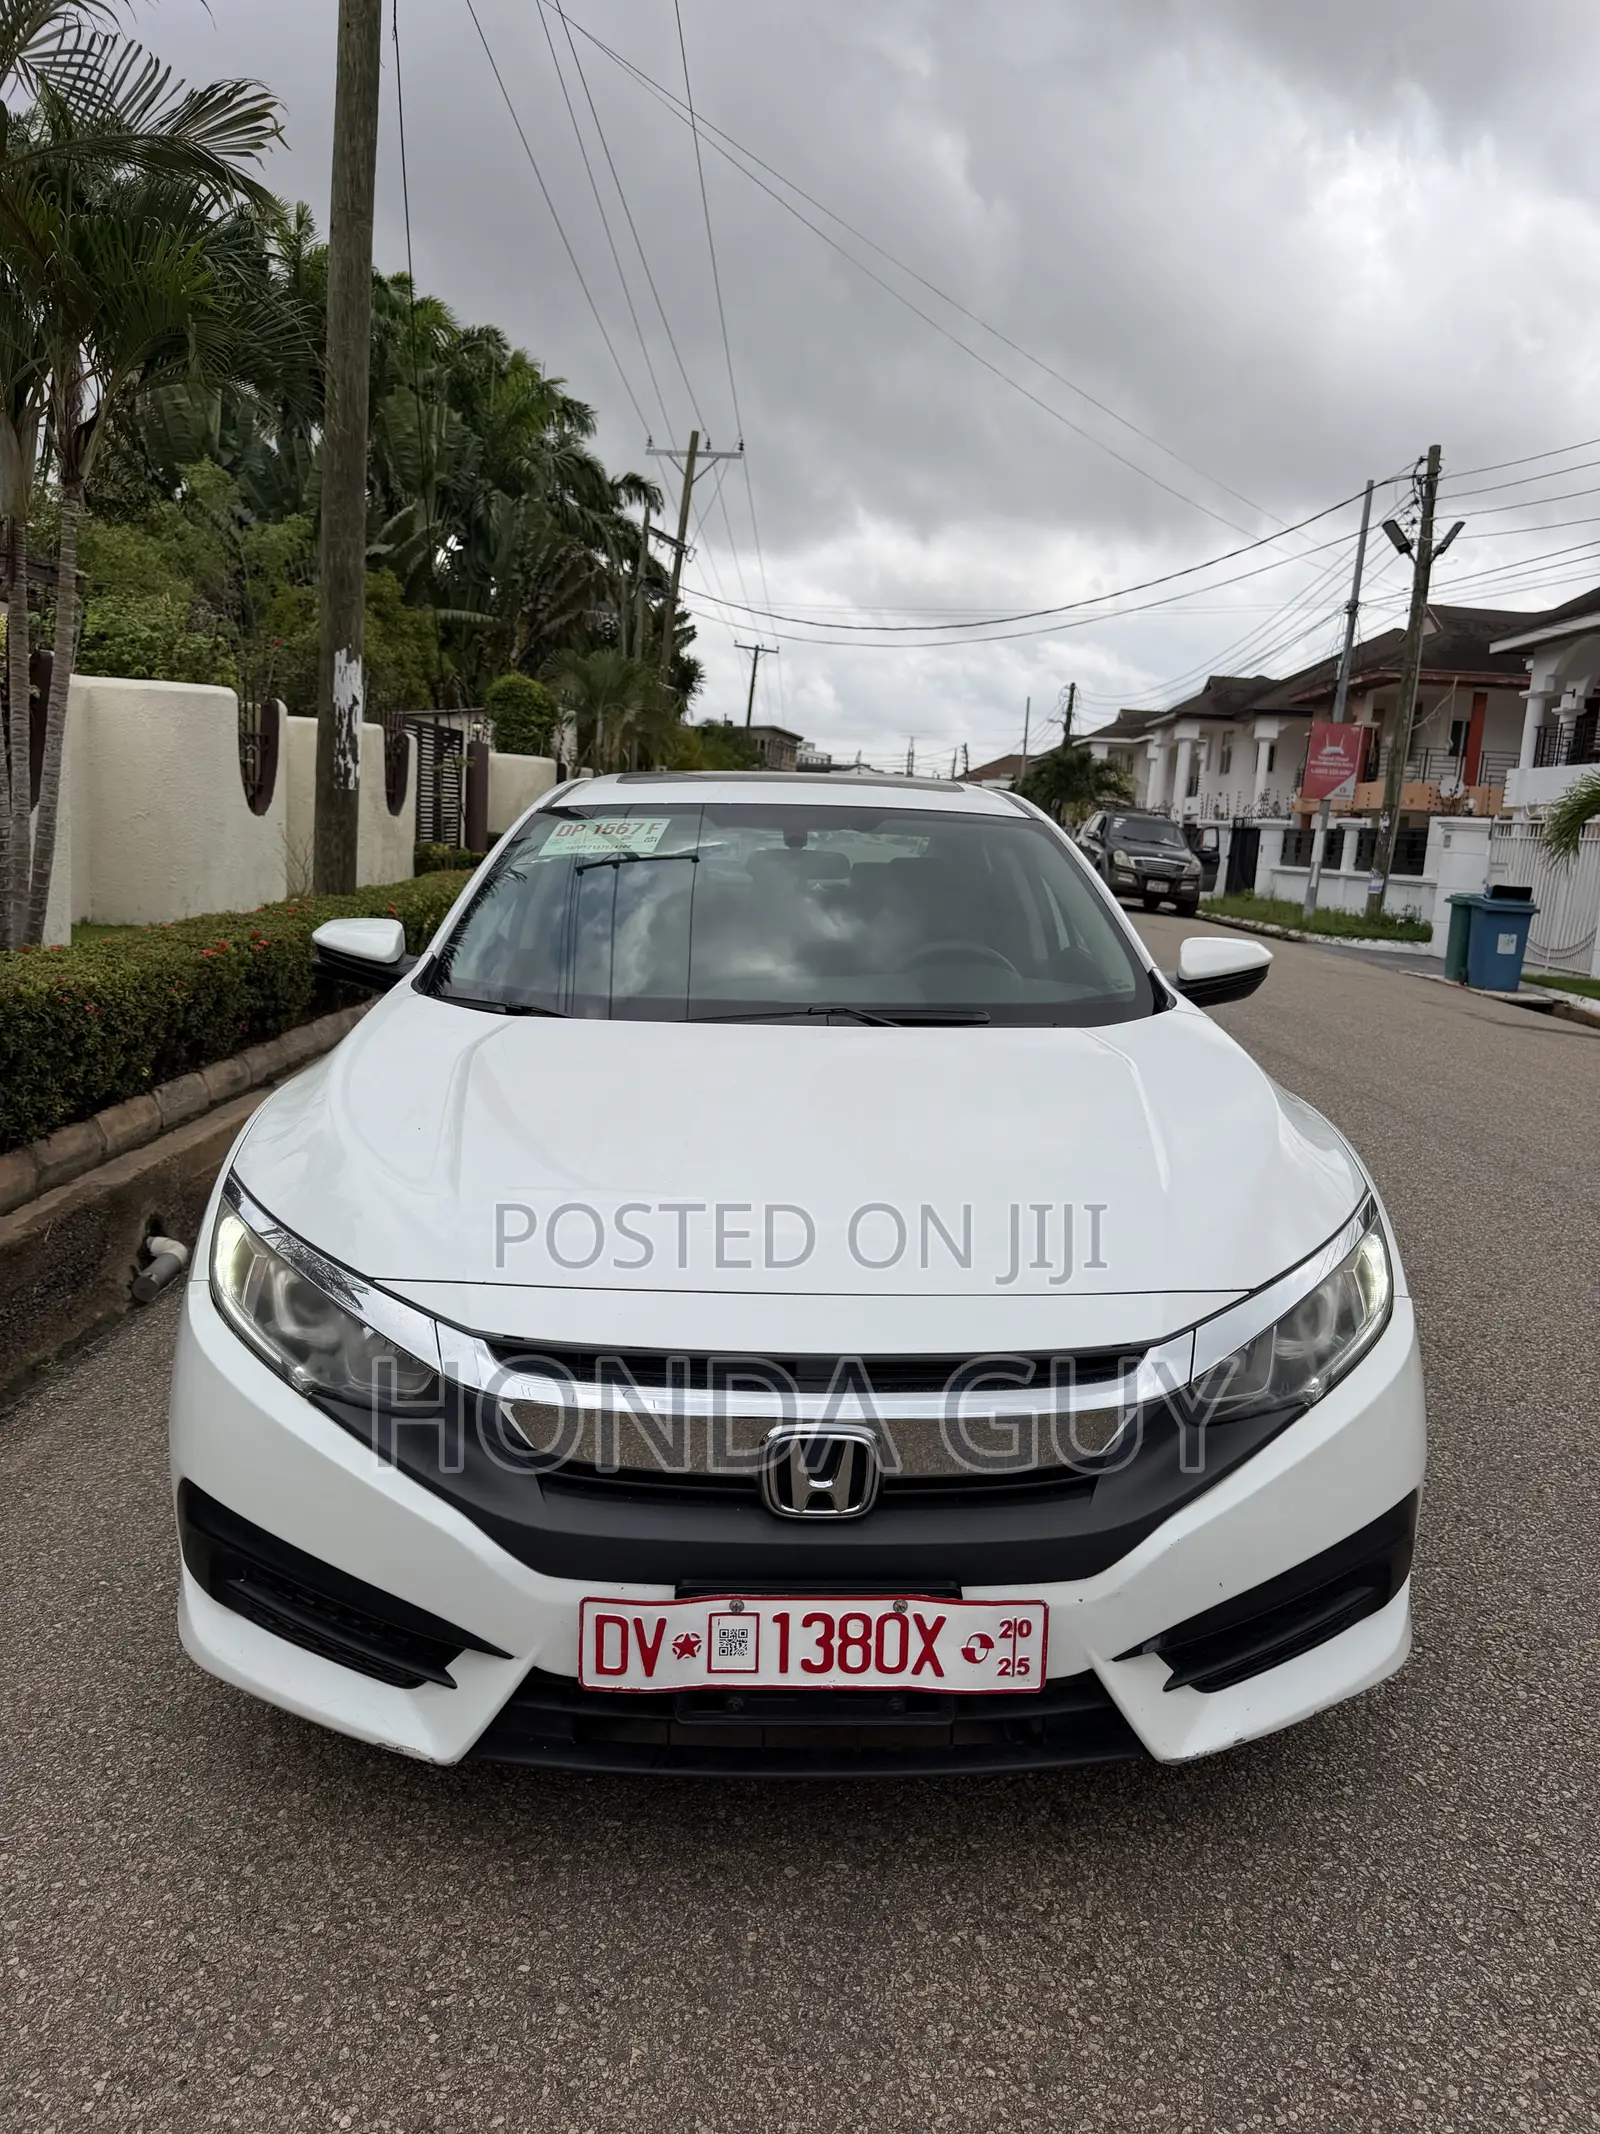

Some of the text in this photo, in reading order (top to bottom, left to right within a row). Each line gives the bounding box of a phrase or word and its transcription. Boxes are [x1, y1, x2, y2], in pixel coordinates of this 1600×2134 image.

[555, 822, 662, 837] DP 1567 F
[998, 1617, 1033, 1639] 20
[595, 1611, 947, 1678] DV 1380X
[996, 1656, 1031, 1677] 25
